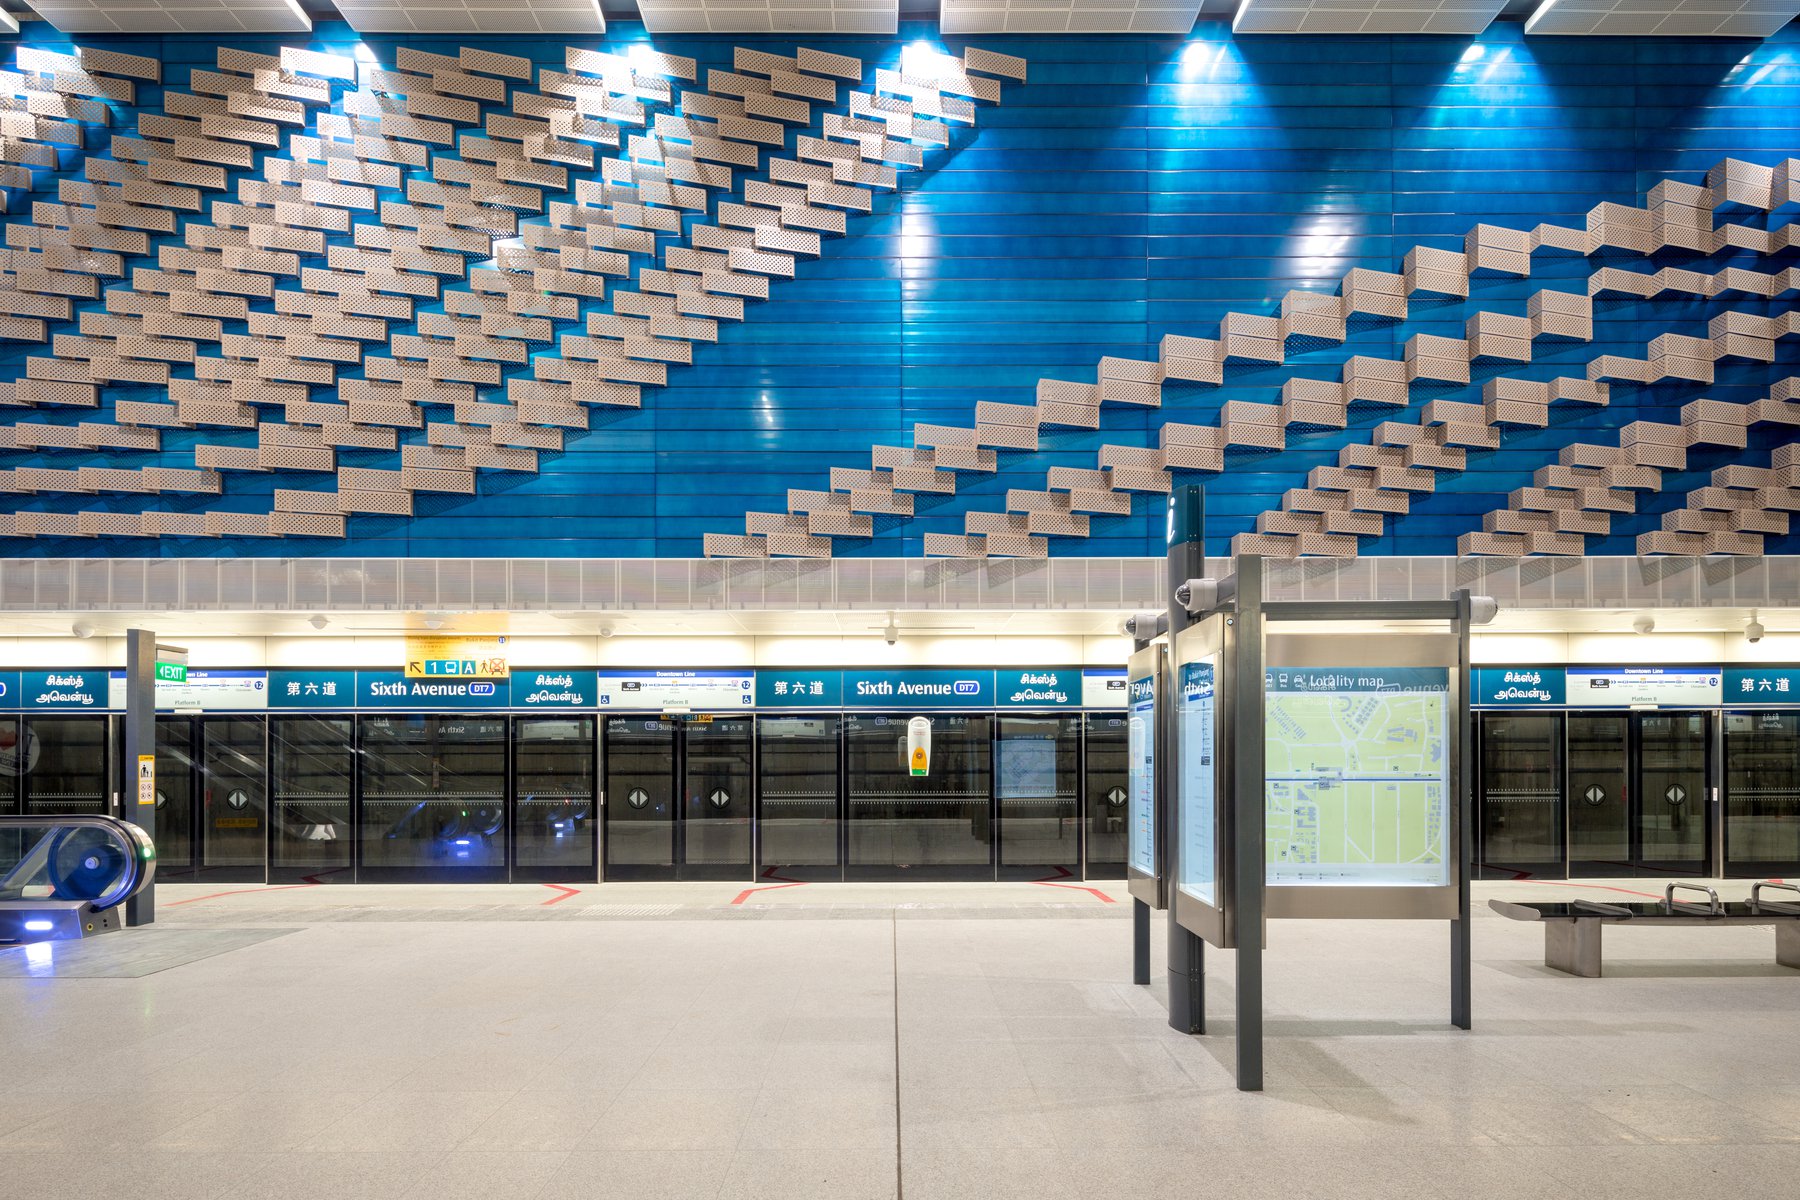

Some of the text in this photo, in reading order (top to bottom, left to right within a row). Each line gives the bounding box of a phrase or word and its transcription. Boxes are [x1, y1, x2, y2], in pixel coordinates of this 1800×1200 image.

[164, 665, 183, 680] EXIT
[431, 661, 437, 674] 1
[464, 662, 474, 674] A
[287, 682, 337, 696] 第六道
[371, 682, 489, 696] Sixth Avenue DT7
[742, 681, 750, 689] 12
[774, 681, 824, 695] 第六道
[857, 681, 975, 695] Sixth Avenue DT7
[1310, 675, 1355, 688] Locality
[1358, 676, 1384, 690] map
[1710, 678, 1718, 686] 12
[1742, 678, 1790, 692] 第六道
